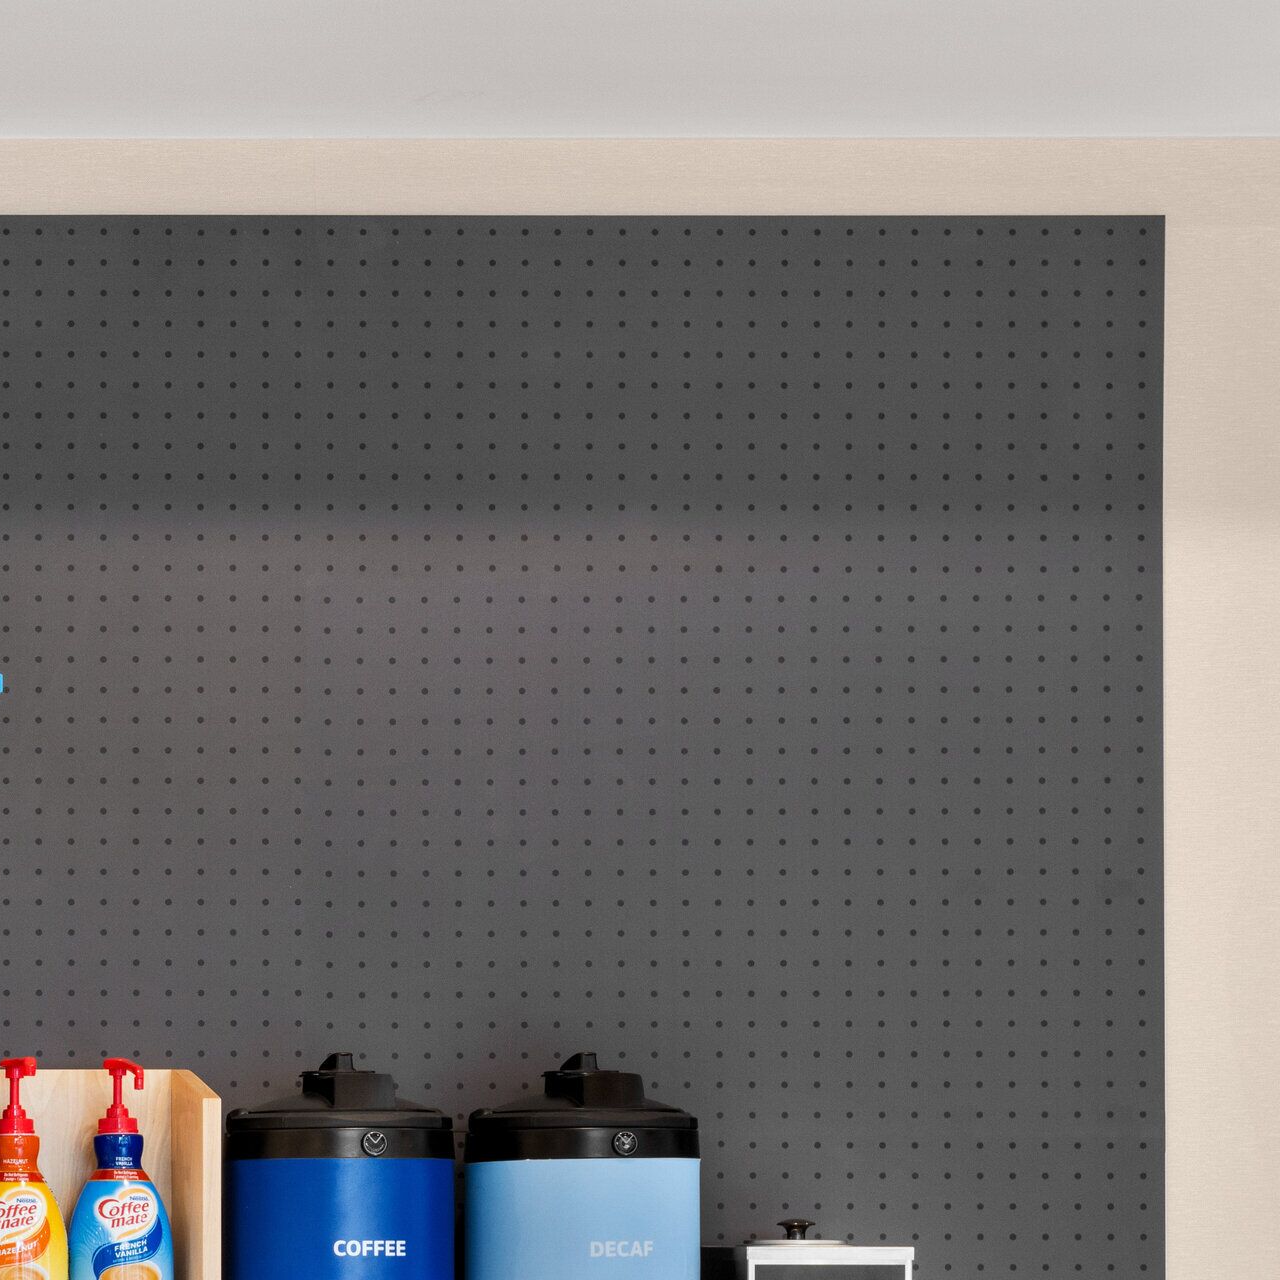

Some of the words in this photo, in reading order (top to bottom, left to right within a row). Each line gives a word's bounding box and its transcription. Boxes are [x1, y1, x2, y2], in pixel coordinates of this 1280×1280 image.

[98, 1199, 150, 1219] Coffee
[110, 1213, 148, 1229] mate
[114, 1239, 148, 1252] FRENCH
[115, 1246, 149, 1258] VANILLA
[333, 1240, 407, 1257] COFFEE
[589, 1241, 654, 1257] DECAF
